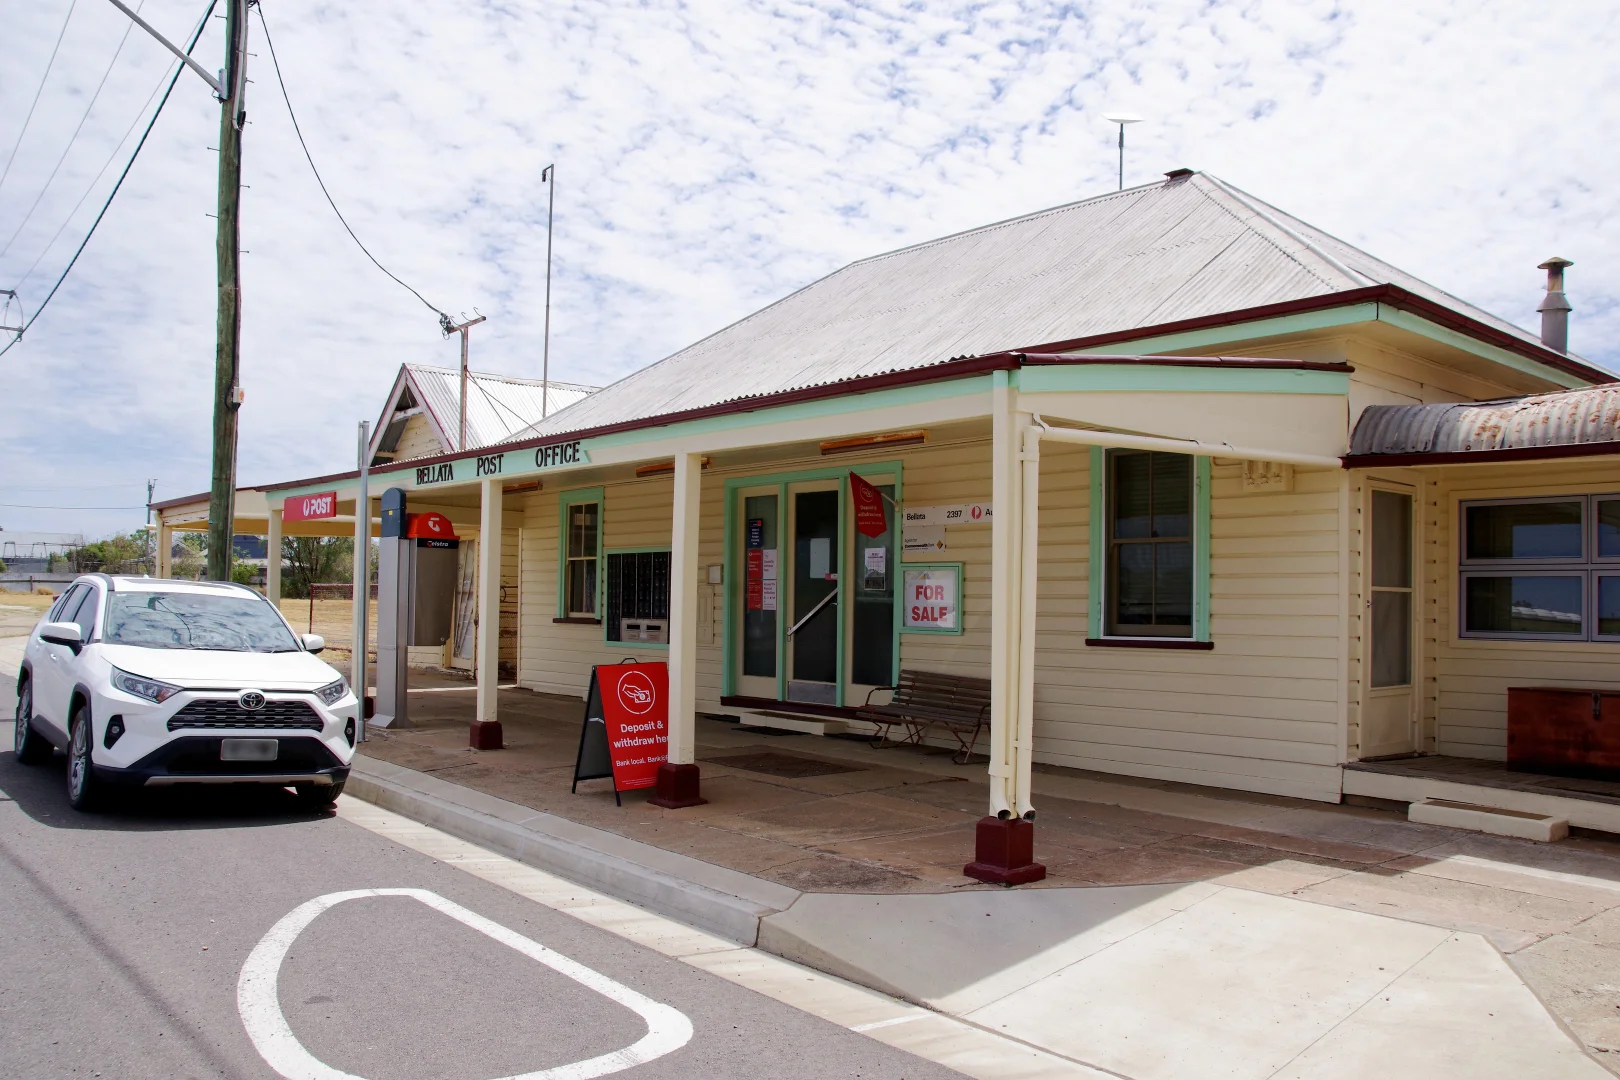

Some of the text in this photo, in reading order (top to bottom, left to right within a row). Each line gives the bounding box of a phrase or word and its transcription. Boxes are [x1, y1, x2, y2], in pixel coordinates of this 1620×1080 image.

[416, 442, 581, 485] BELLATA POST OFFICE
[310, 496, 332, 515] POST
[906, 512, 926, 521] Bellata
[946, 510, 962, 519] 2397
[426, 540, 449, 548] Telstra
[915, 584, 945, 601] FOR
[911, 605, 948, 622] SALE
[620, 720, 664, 734] Deposit &
[613, 736, 655, 748] withdraw
[616, 758, 630, 767] Bank
